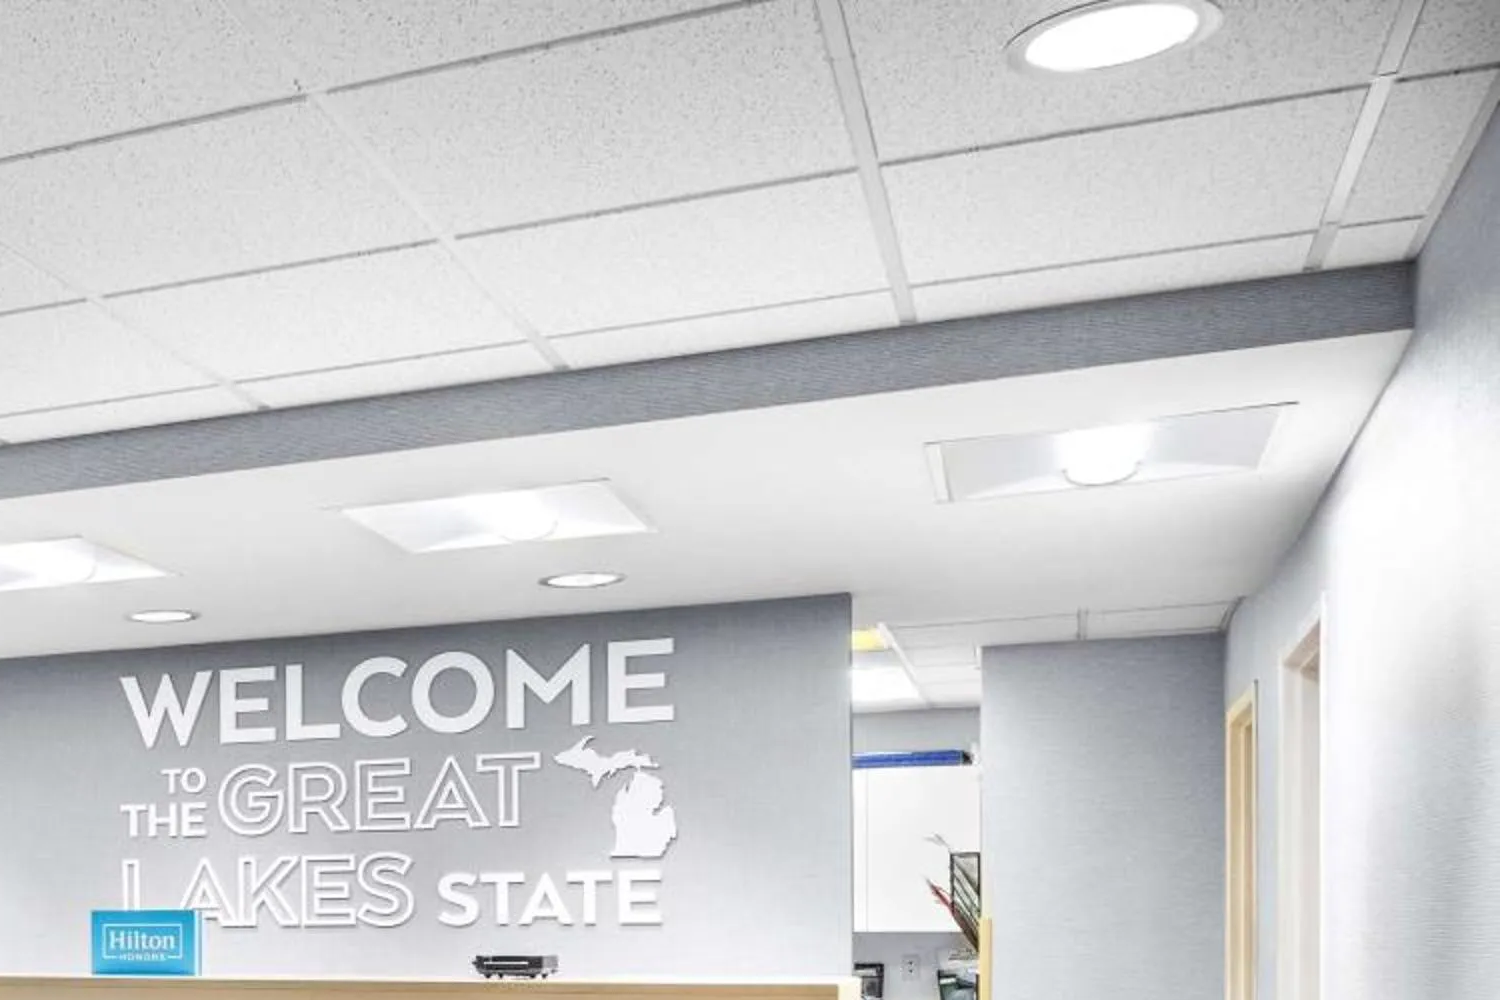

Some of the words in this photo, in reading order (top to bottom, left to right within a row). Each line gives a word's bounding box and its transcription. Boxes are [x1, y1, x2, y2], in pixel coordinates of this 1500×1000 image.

[120, 638, 675, 748] WELCOME
[120, 801, 208, 838] THE
[218, 752, 541, 836] GREAT
[160, 767, 206, 794] TO
[437, 869, 662, 926] STATE
[108, 929, 176, 950] Hilton
